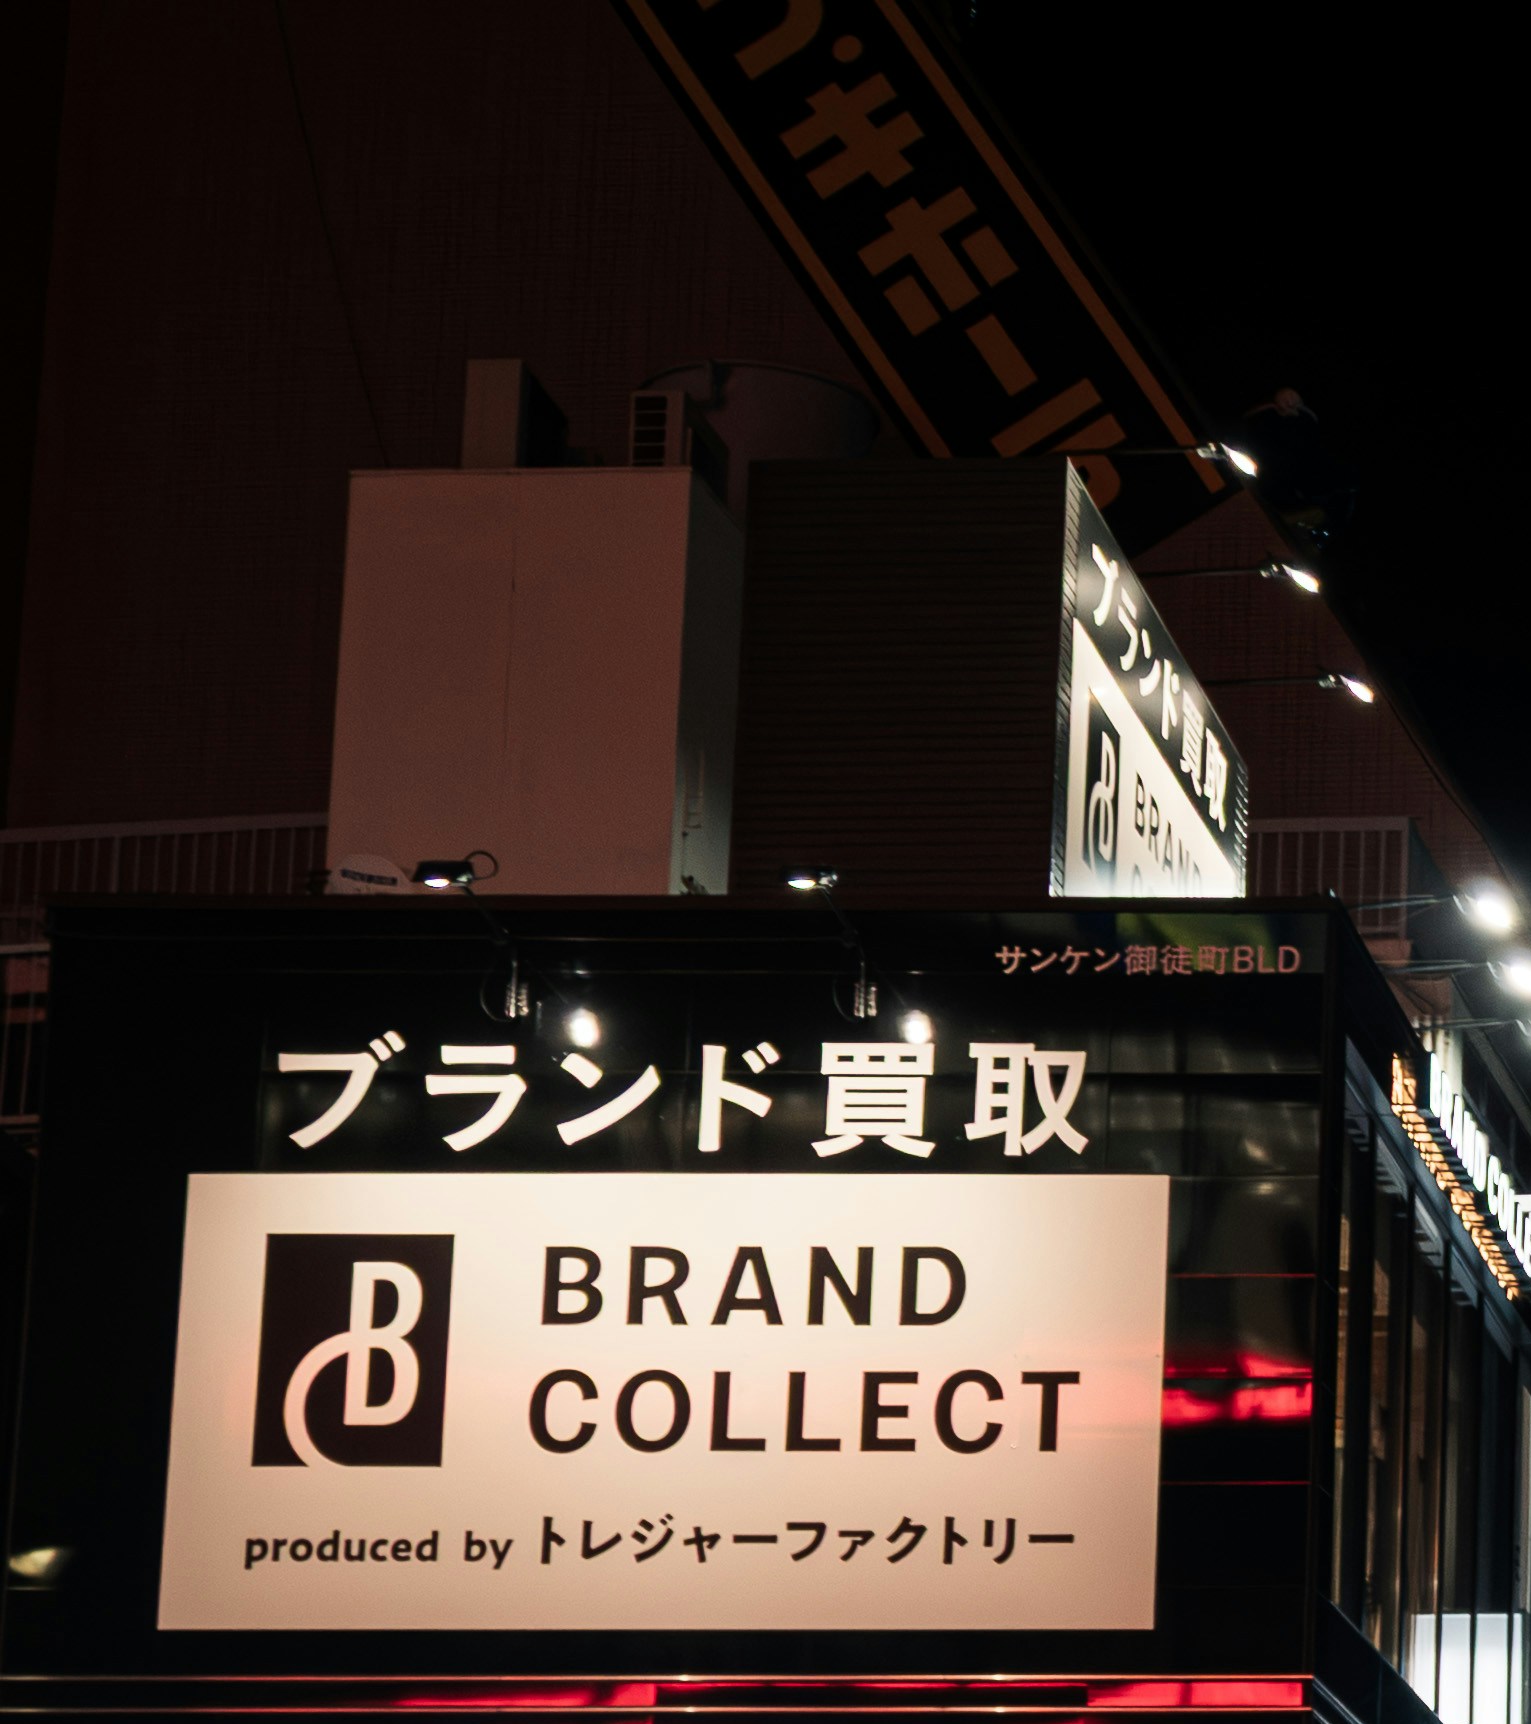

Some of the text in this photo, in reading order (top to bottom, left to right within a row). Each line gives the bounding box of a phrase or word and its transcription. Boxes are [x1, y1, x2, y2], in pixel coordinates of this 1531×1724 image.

[1091, 543, 1228, 832] ブランド買取
[995, 944, 1301, 976] サンケン御徒町BLD
[276, 1030, 1089, 1156] ブランド買取
[1430, 1052, 1489, 1192] BRAND
[540, 1245, 968, 1327] BRAND
[528, 1369, 1081, 1455] COLLECT
[244, 1515, 1076, 1570] produced by トレジャーファクトリー
